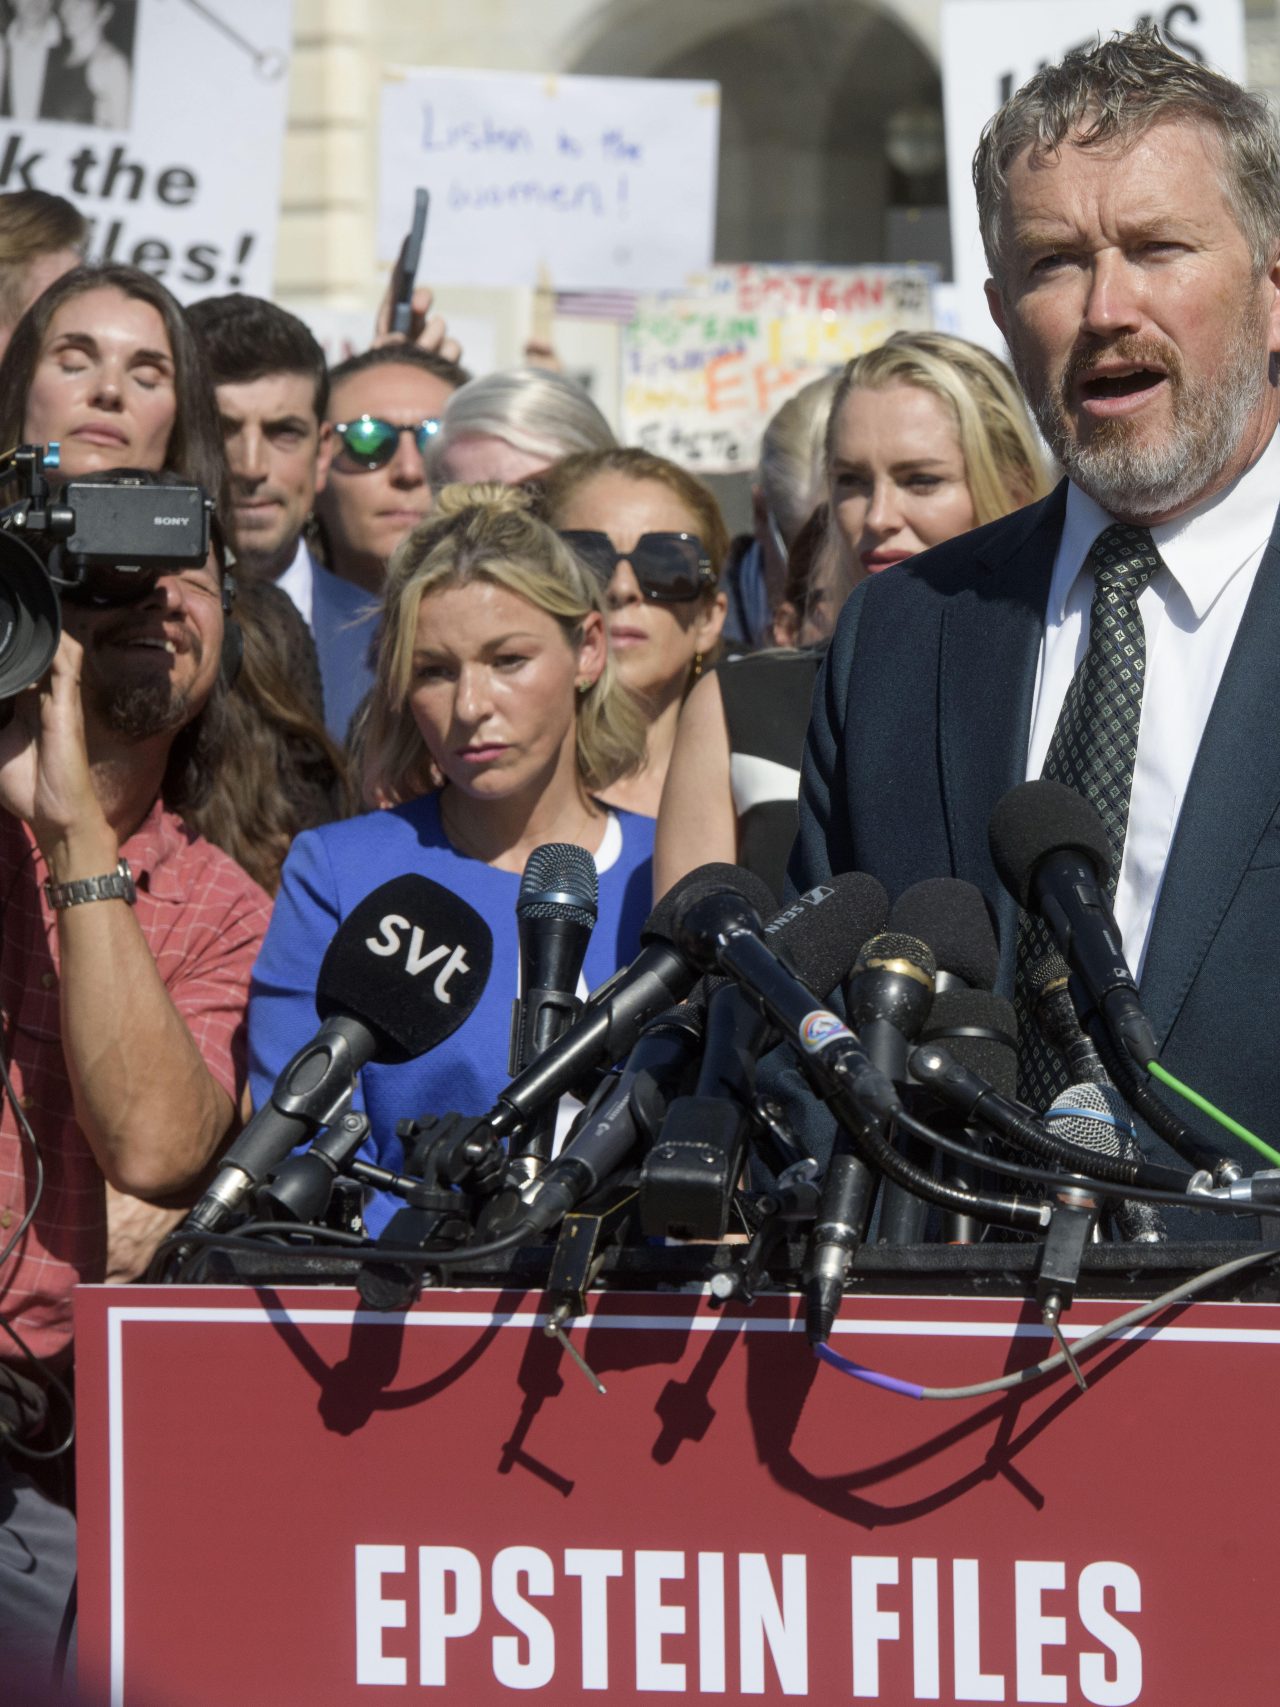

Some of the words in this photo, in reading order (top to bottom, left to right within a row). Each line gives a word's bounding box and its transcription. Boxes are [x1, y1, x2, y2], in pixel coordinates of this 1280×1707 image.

[69, 145, 198, 207] the
[153, 516, 190, 526] SONY
[365, 914, 471, 1004] svt
[355, 1544, 808, 1696] EPSTEIN
[851, 1555, 1142, 1707] FILES
